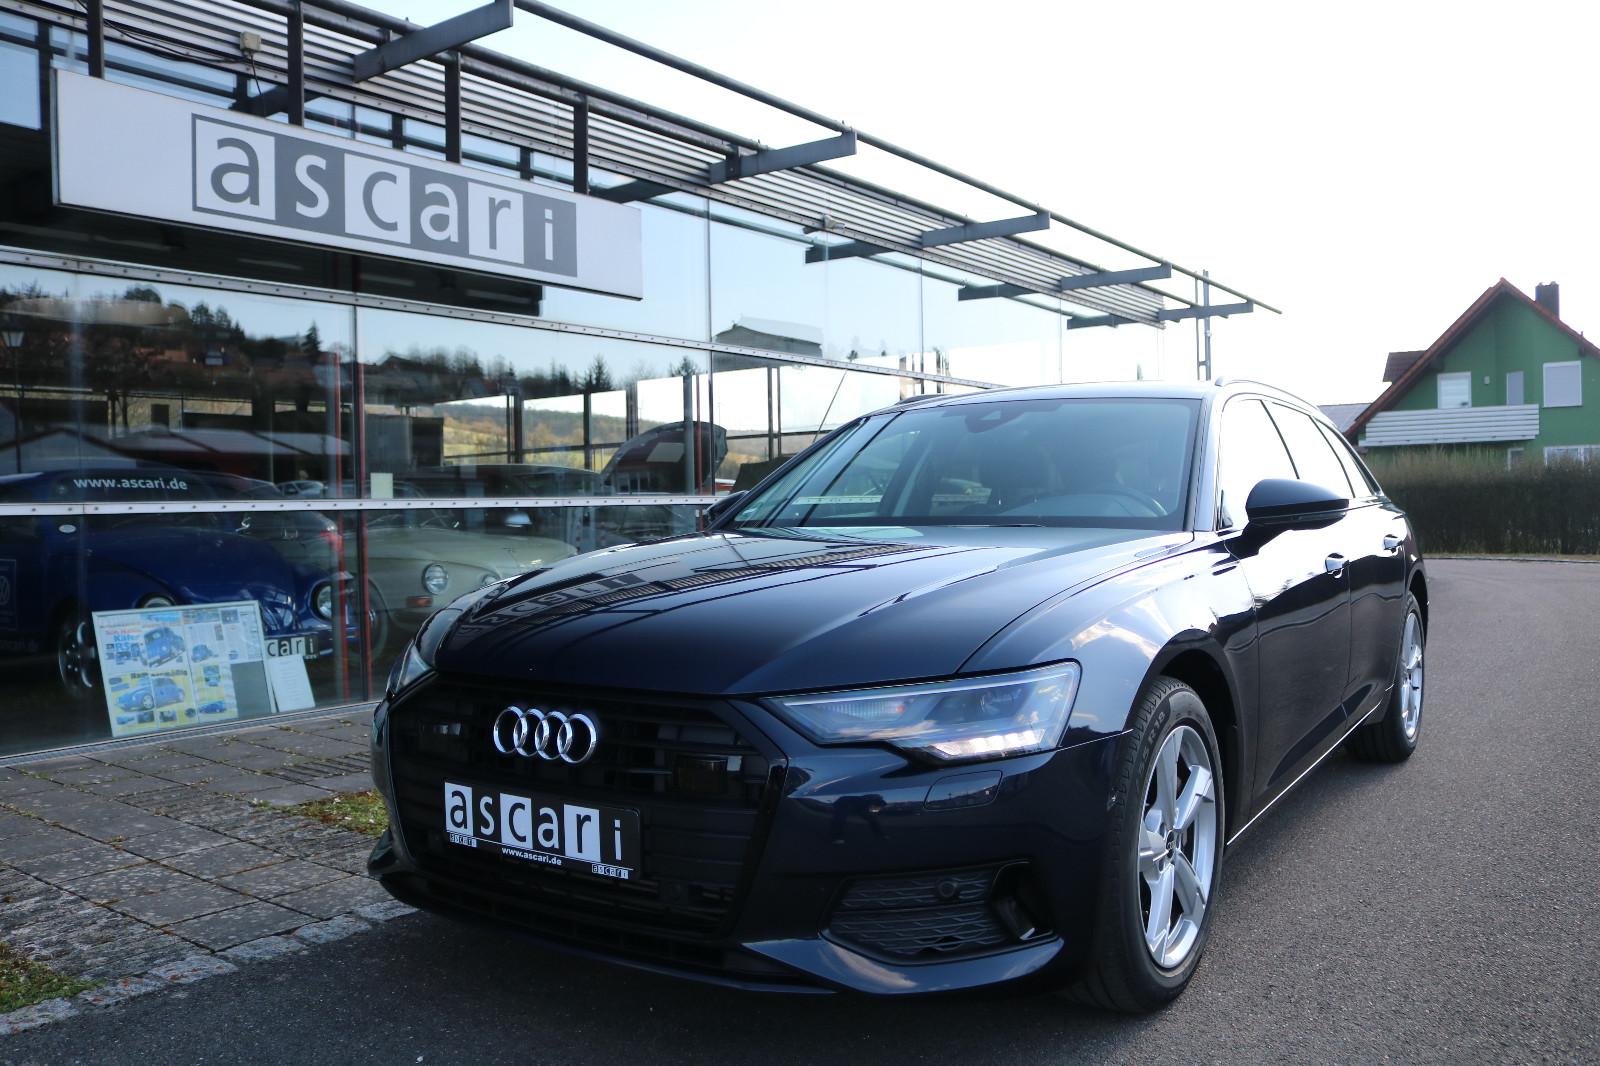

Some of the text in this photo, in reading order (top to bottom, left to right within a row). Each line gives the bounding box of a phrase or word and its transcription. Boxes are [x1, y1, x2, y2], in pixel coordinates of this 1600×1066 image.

[208, 133, 556, 263] ascari
[73, 476, 188, 492] www.ascari.de
[447, 785, 623, 861] ascari
[450, 833, 477, 848] ascari
[501, 847, 562, 866] www.ascari.de
[592, 864, 629, 880] ascari
